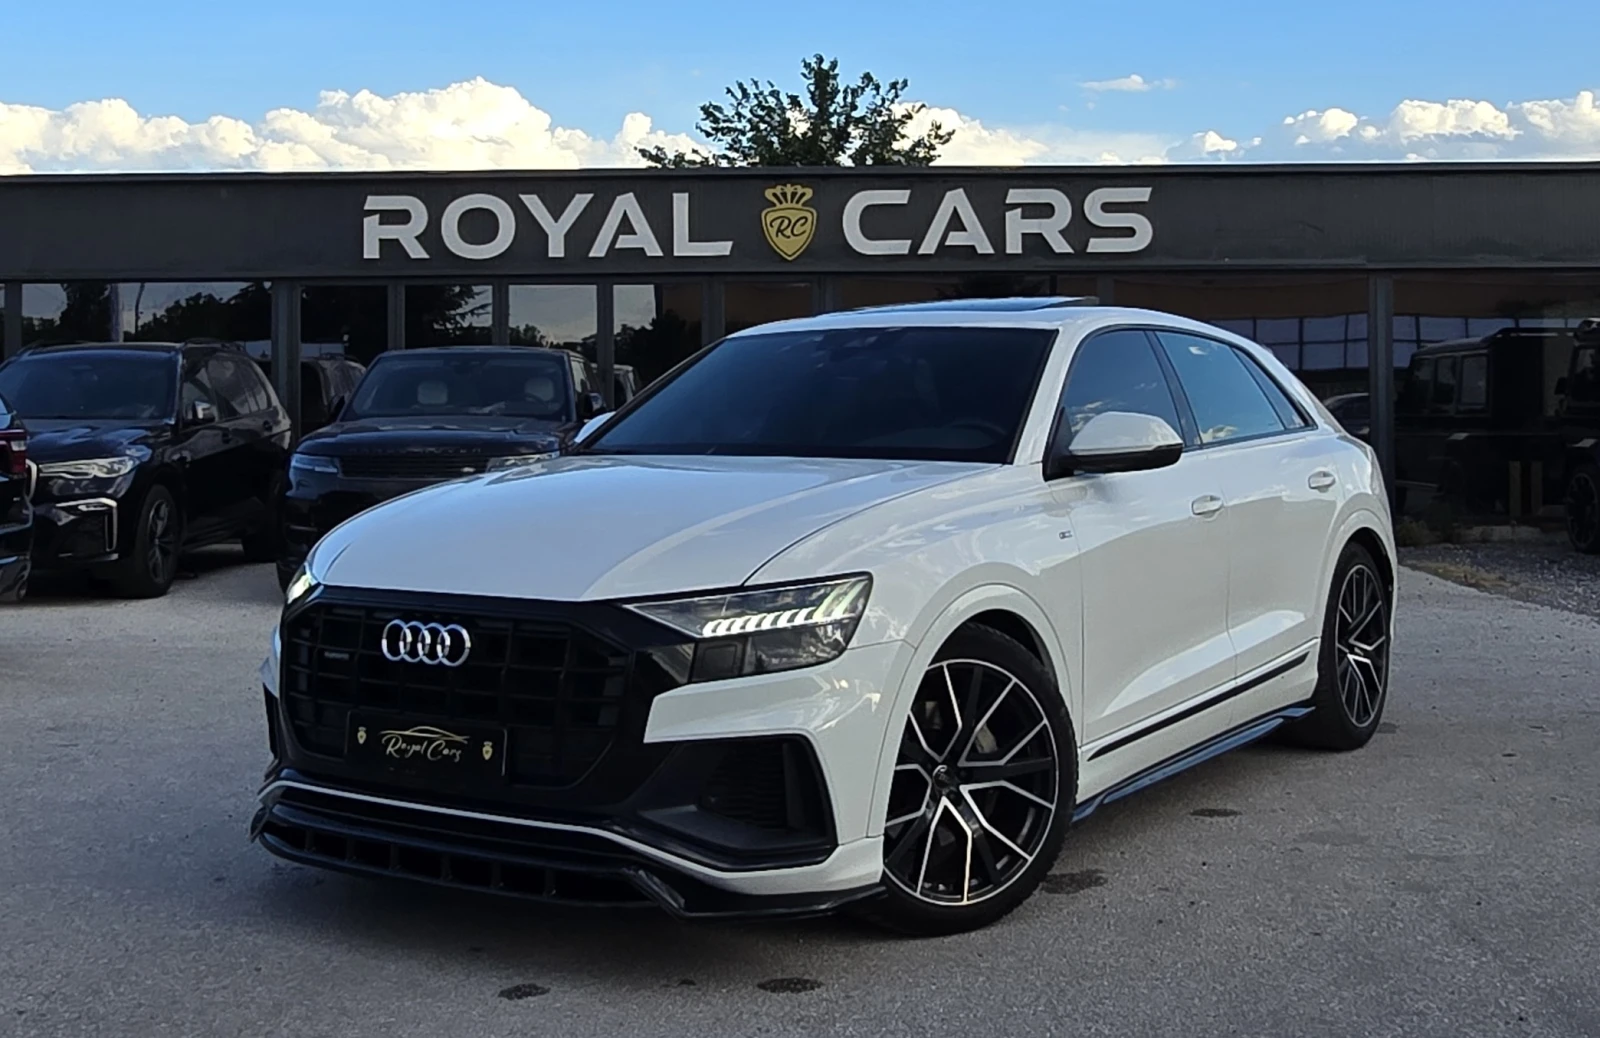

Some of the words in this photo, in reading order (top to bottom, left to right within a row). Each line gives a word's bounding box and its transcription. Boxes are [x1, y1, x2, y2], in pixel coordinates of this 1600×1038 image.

[362, 192, 733, 260] ROYAL
[842, 186, 1153, 257] CARS
[769, 215, 809, 239] RC
[382, 734, 427, 758] Royal
[427, 739, 462, 763] Cars
